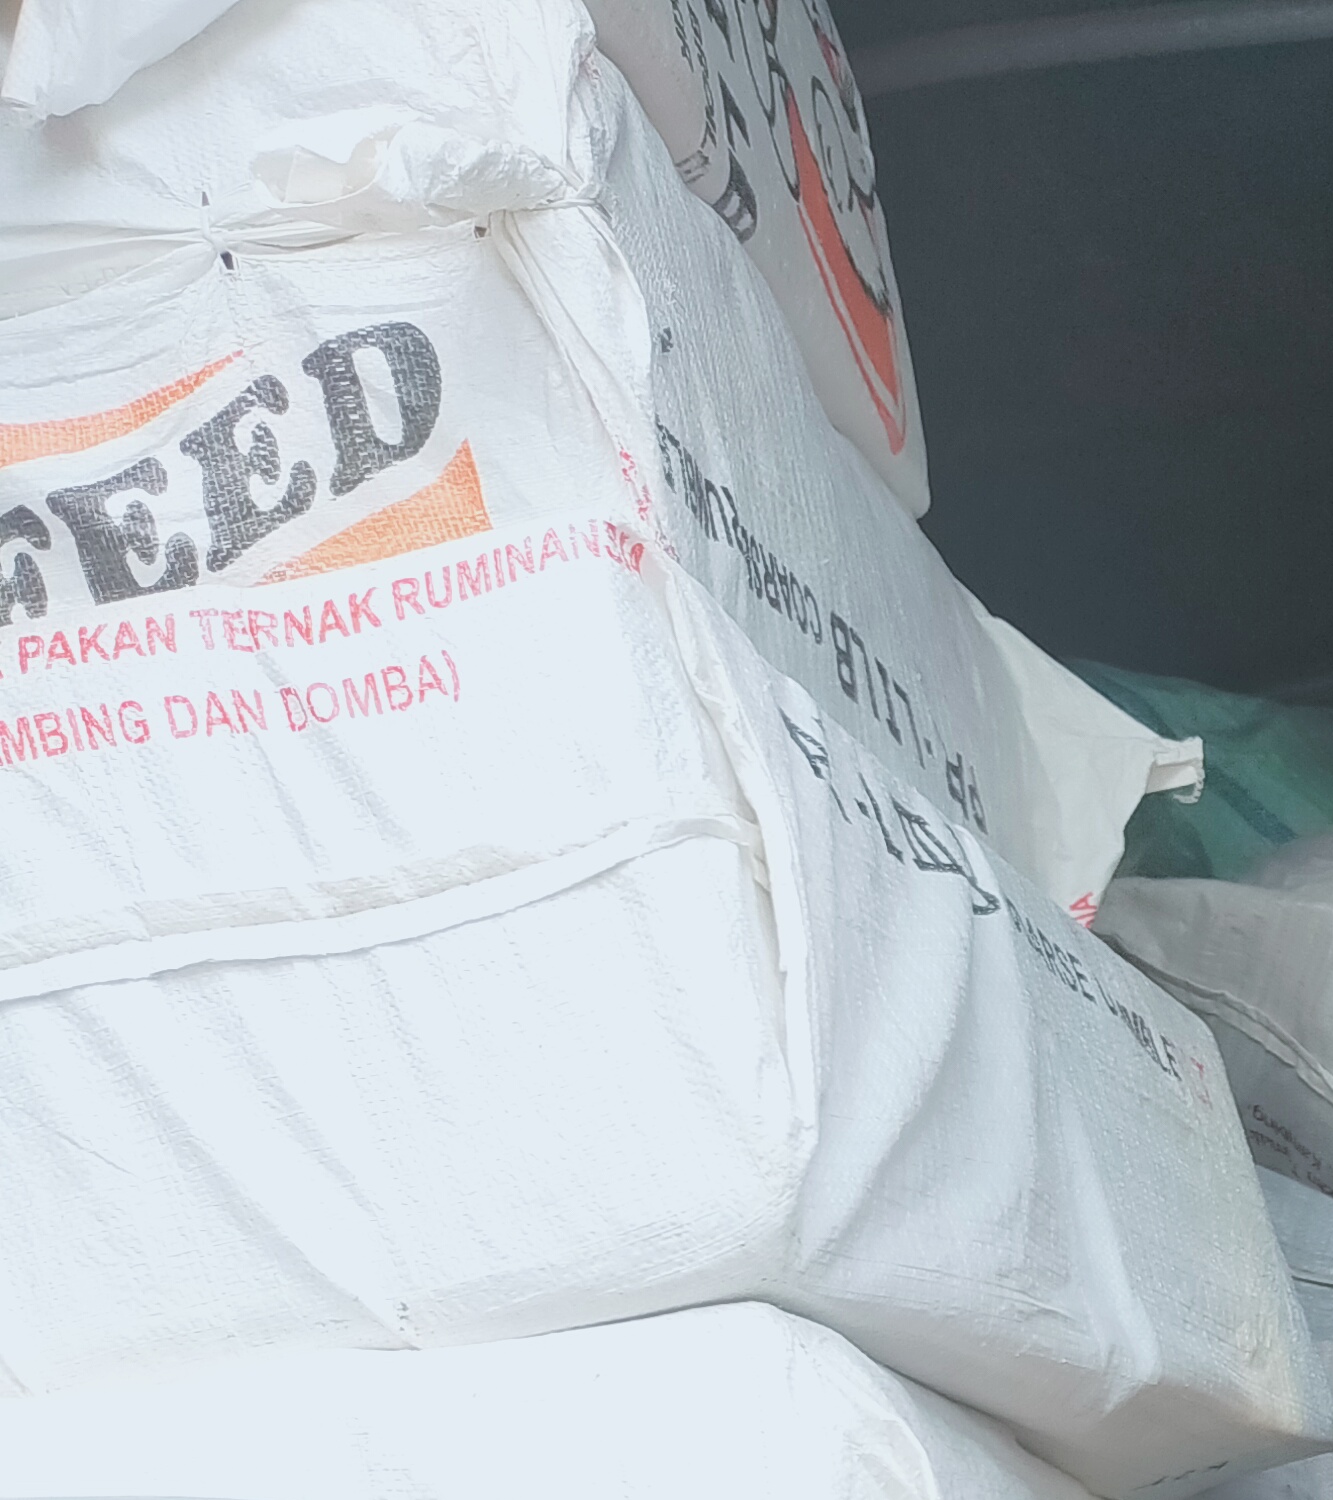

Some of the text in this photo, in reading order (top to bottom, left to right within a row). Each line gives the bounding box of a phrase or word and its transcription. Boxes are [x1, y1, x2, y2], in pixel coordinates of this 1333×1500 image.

[17, 613, 177, 676] PAKAN
[188, 585, 382, 653] TERNAK
[0, 646, 464, 768] MBING DAN DOMBA)
